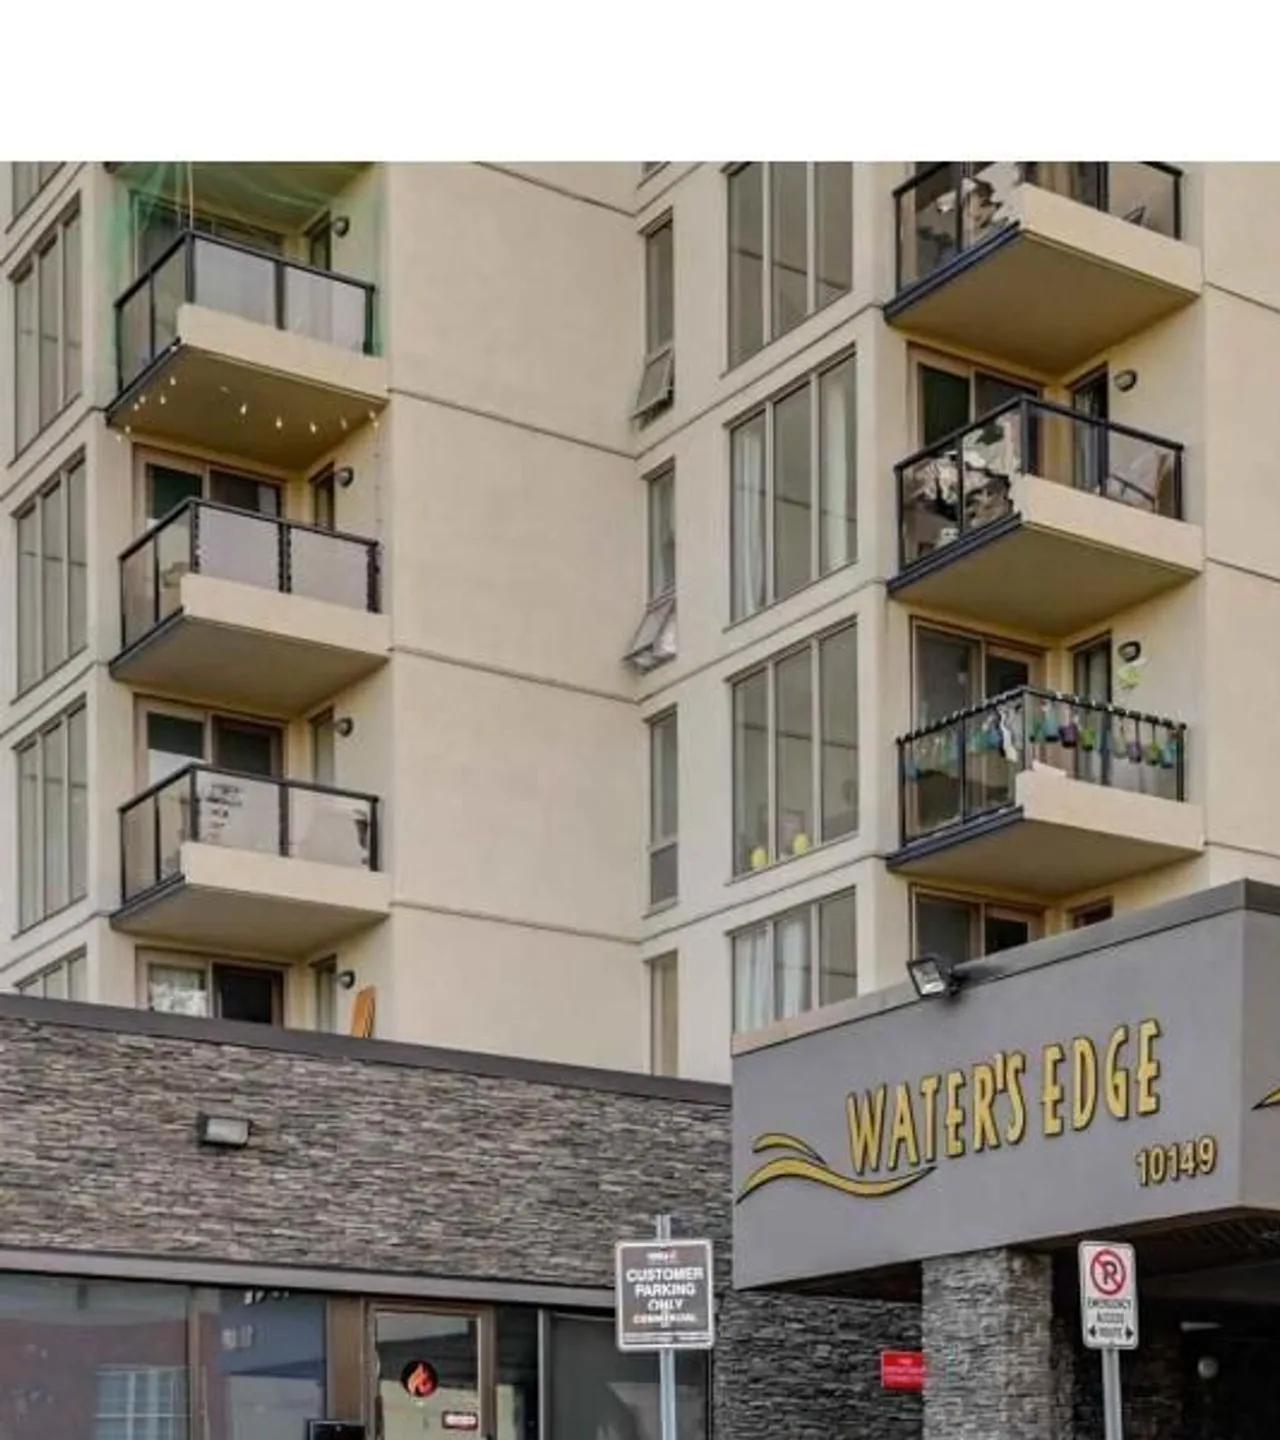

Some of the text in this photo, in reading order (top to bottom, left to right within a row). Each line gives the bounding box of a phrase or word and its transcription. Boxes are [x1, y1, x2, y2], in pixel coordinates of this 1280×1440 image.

[845, 1019, 1162, 1175] WATER'S EDGE
[1135, 1135, 1219, 1187] 10149
[625, 1266, 705, 1283] CUSTOMER
[634, 1282, 697, 1298] PARKING
[646, 1298, 684, 1312] ONLY
